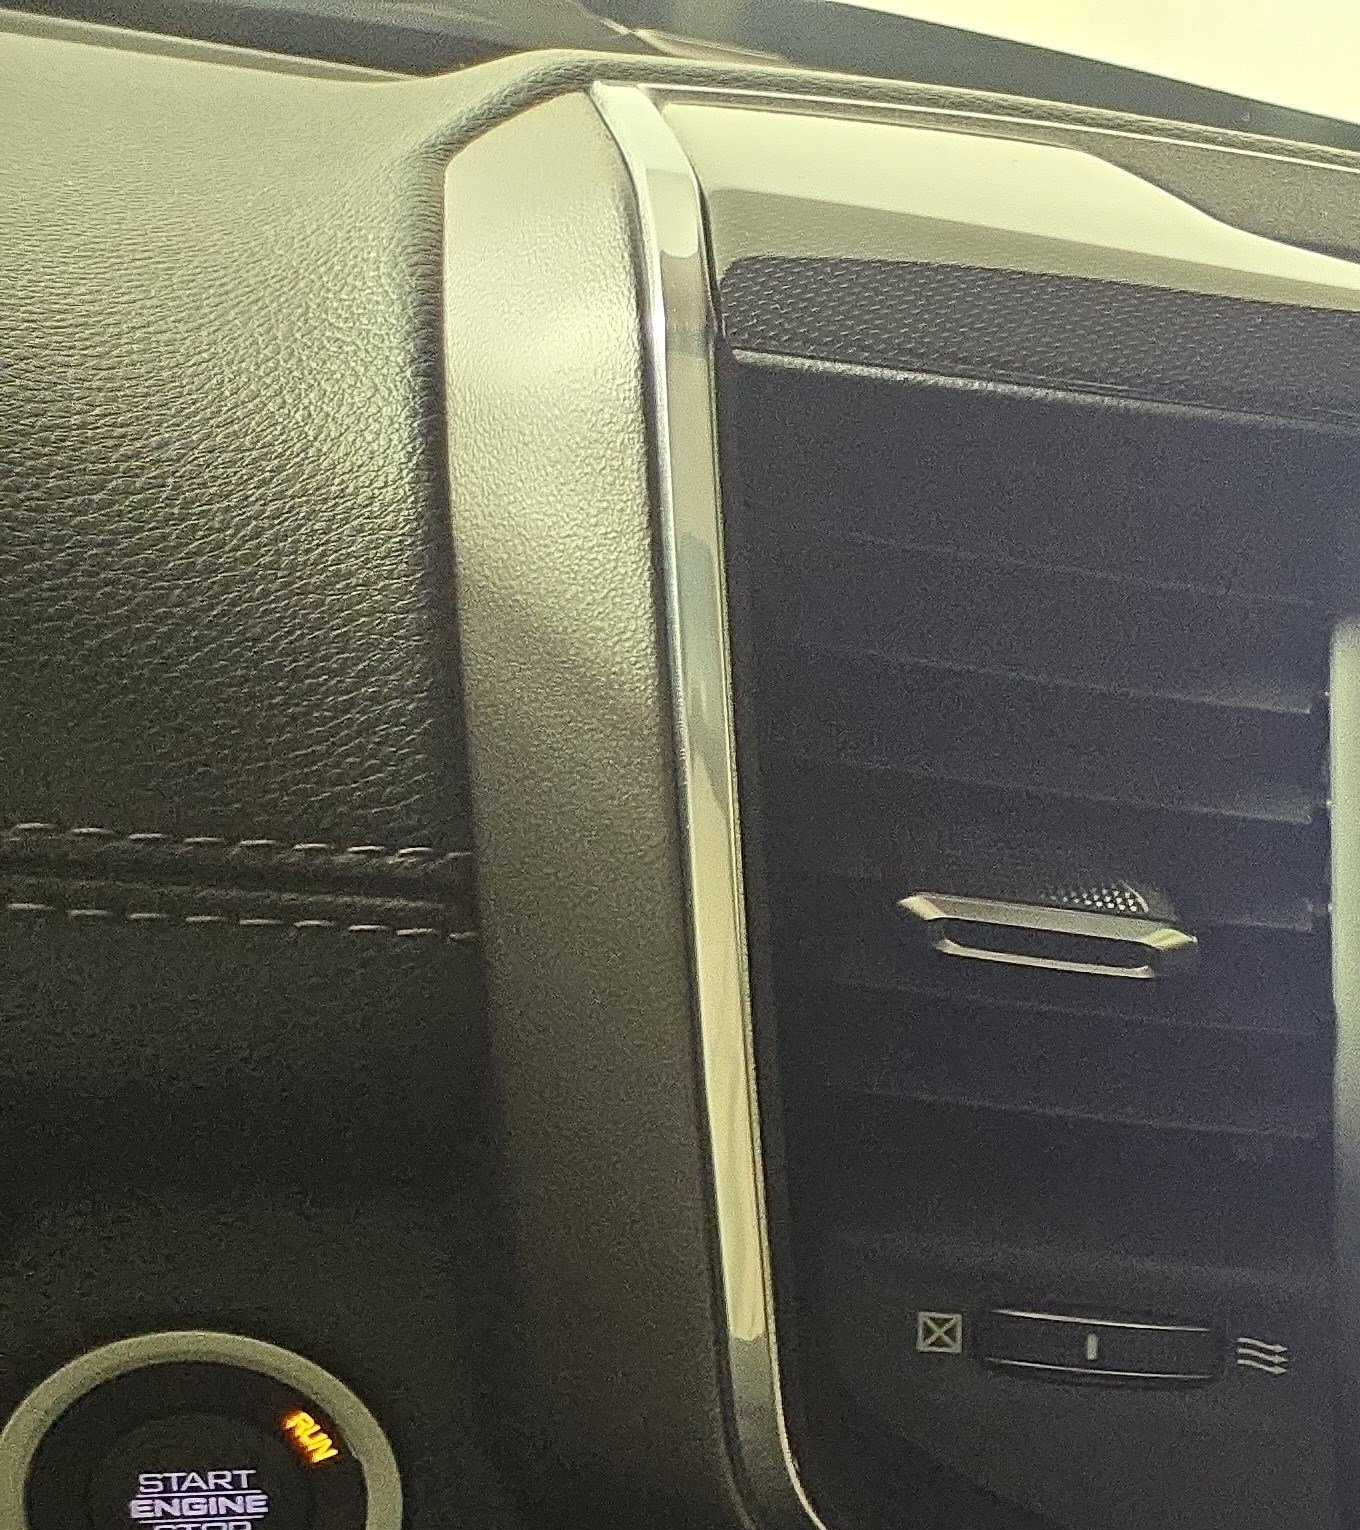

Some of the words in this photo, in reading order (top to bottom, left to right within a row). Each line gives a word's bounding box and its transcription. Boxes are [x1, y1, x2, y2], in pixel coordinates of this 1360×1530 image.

[285, 1409, 339, 1464] RUN
[138, 1469, 257, 1494] START
[130, 1494, 269, 1519] ENGINE
